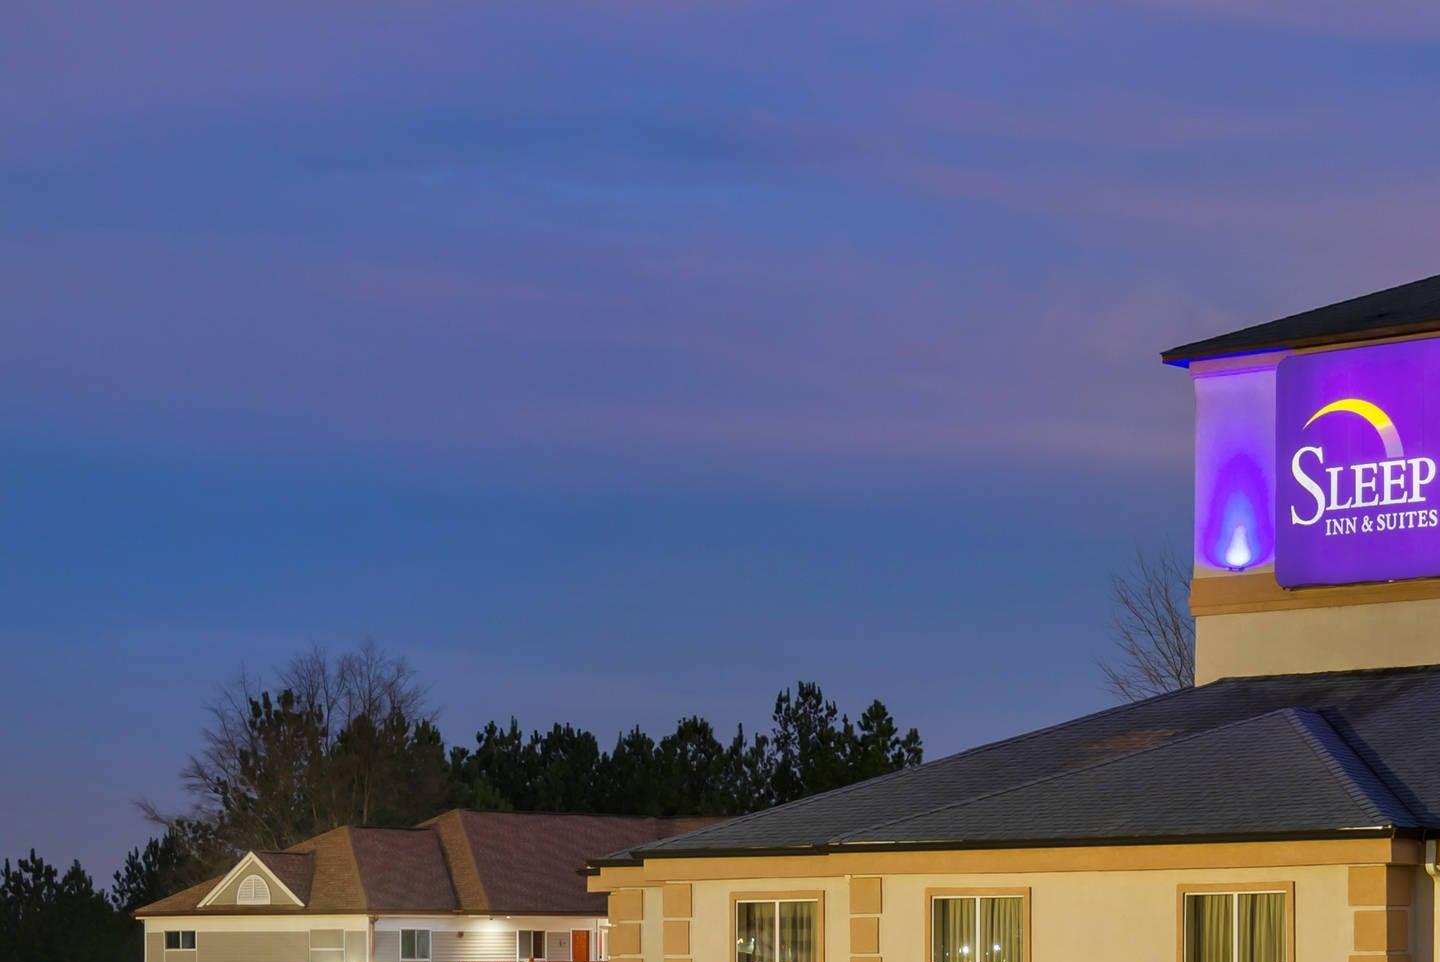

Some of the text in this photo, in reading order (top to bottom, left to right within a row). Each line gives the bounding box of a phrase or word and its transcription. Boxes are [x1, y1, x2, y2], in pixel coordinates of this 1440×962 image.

[1290, 446, 1436, 526] SLEEP
[1325, 509, 1439, 536] INN & SUITES
